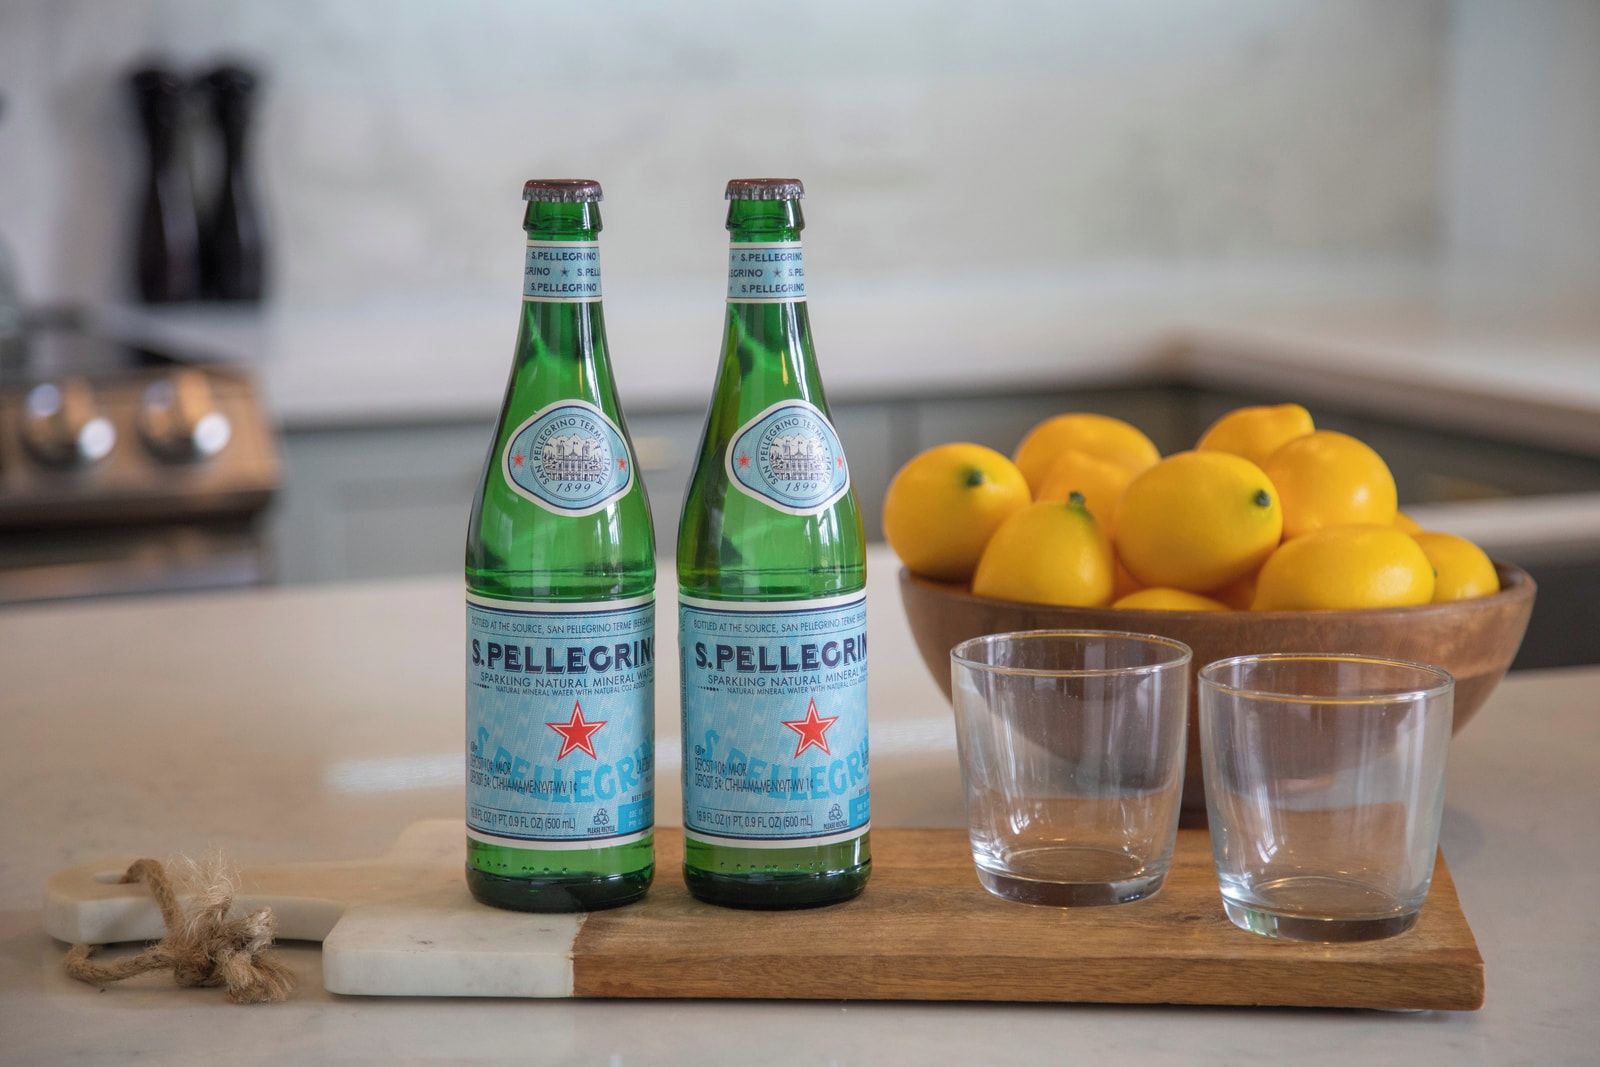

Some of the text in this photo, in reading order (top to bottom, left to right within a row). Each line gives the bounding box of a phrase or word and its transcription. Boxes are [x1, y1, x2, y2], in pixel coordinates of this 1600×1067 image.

[531, 251, 597, 261] S.PELLEGRINO
[531, 283, 597, 292] S.PELLEGRINO
[760, 418, 799, 461] PELLEGRINO
[533, 418, 605, 485] SAN PELLEGRINO TERME
[595, 458, 611, 485] ITALIA
[763, 465, 779, 485] SAN
[556, 482, 591, 492] 1899
[785, 482, 817, 492] 1899
[498, 621, 510, 631] THE
[512, 623, 545, 635] SOURCE,
[547, 625, 564, 634] SAN
[566, 623, 611, 634] PELLEGRINO
[613, 620, 632, 631] TERME
[694, 619, 717, 631] BOTTLED
[720, 623, 727, 631] AT
[729, 623, 742, 632] THE
[744, 624, 779, 634] SOURCE,
[781, 623, 798, 632] SAN
[800, 619, 840, 631] PELLEGRINO
[841, 615, 856, 626] TERME
[480, 671, 531, 687] SPARKLING
[535, 678, 589, 689] NATURAL
[592, 673, 635, 687] MINERAL
[708, 674, 766, 687] SPARKLING
[770, 675, 821, 687] NATURAL
[825, 669, 859, 683] MINERAL
[496, 685, 520, 694] NATURAL
[522, 688, 549, 696] MINERAL
[575, 688, 592, 696] WITH
[594, 686, 620, 695] NATURAL
[727, 687, 754, 695] NATURAL
[788, 687, 808, 695] WATER
[809, 684, 825, 693] WITH
[826, 681, 849, 691] NATURAL
[484, 811, 491, 823] OZ
[509, 816, 519, 827] 0.9
[520, 817, 529, 828] FL
[531, 817, 543, 830] OZ)
[544, 817, 560, 831] (500
[562, 817, 576, 831] mL)
[707, 812, 714, 824] FL
[715, 813, 724, 825] OZ
[744, 816, 756, 828] 0.9
[757, 816, 766, 828] FL
[769, 816, 782, 830] OZ)
[783, 815, 798, 829] (500
[799, 814, 813, 827] mL)
